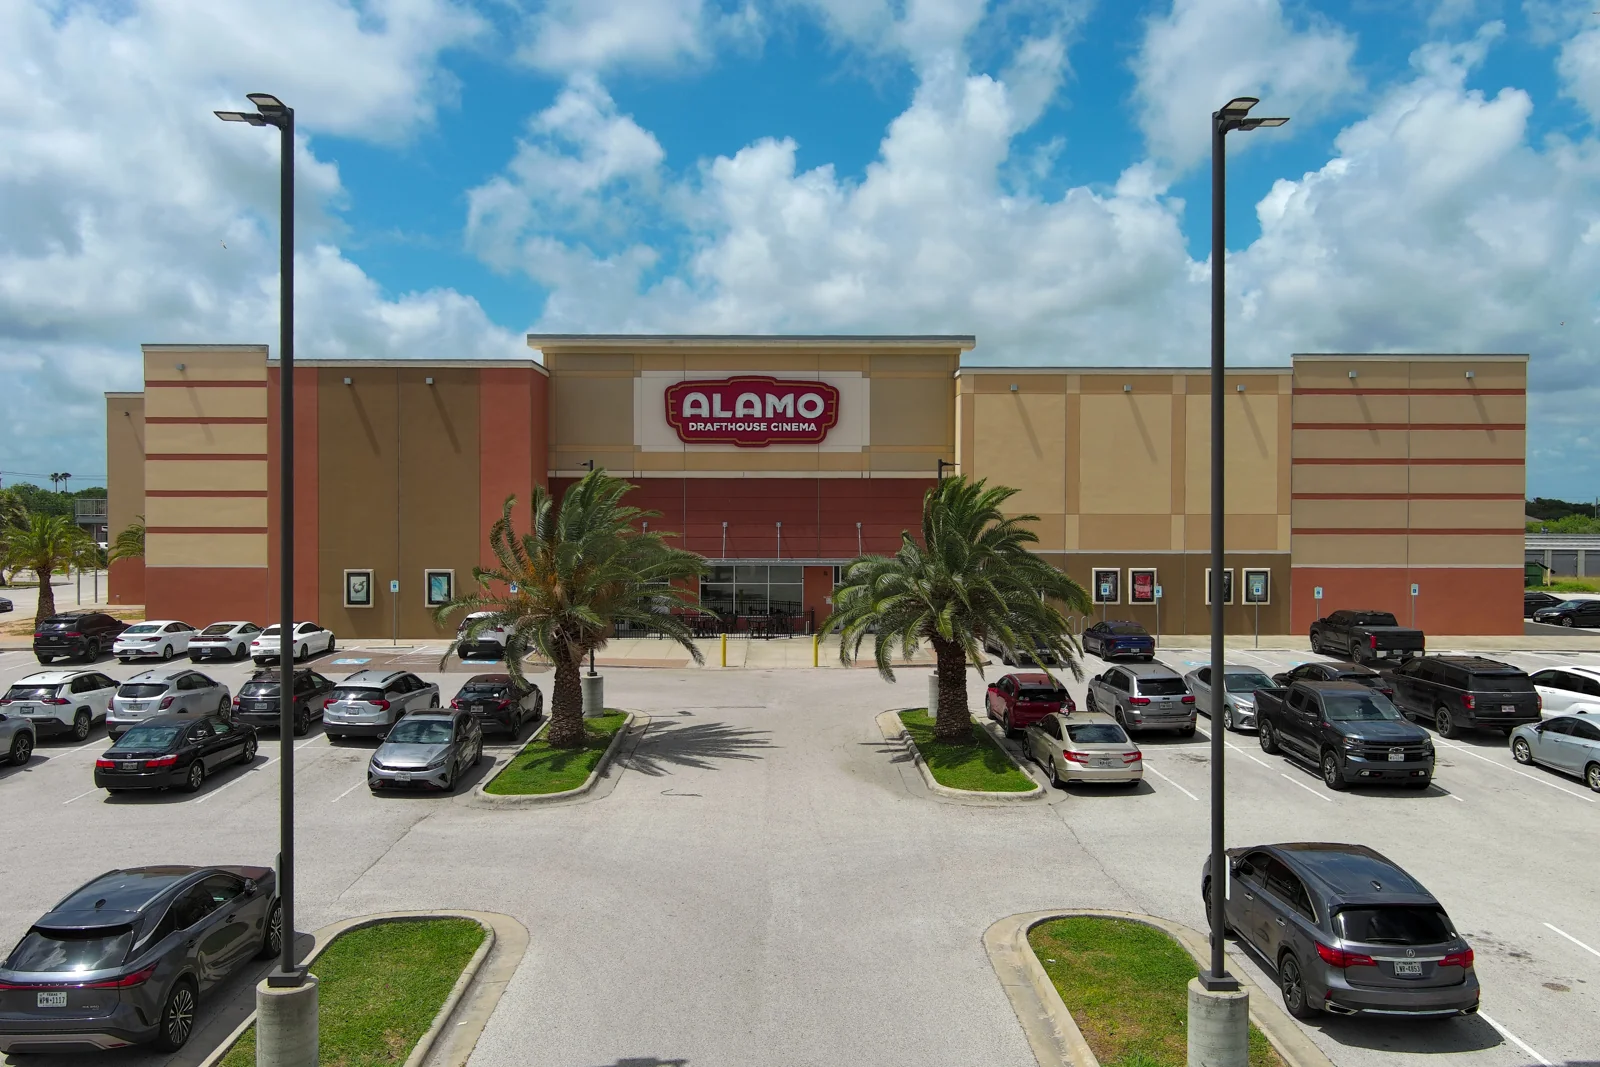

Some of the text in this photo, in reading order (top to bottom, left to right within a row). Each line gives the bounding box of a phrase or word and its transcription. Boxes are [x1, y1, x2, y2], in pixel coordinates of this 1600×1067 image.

[682, 392, 825, 419] ALAMO
[689, 422, 817, 431] DRAFTHOUSE CINEMA
